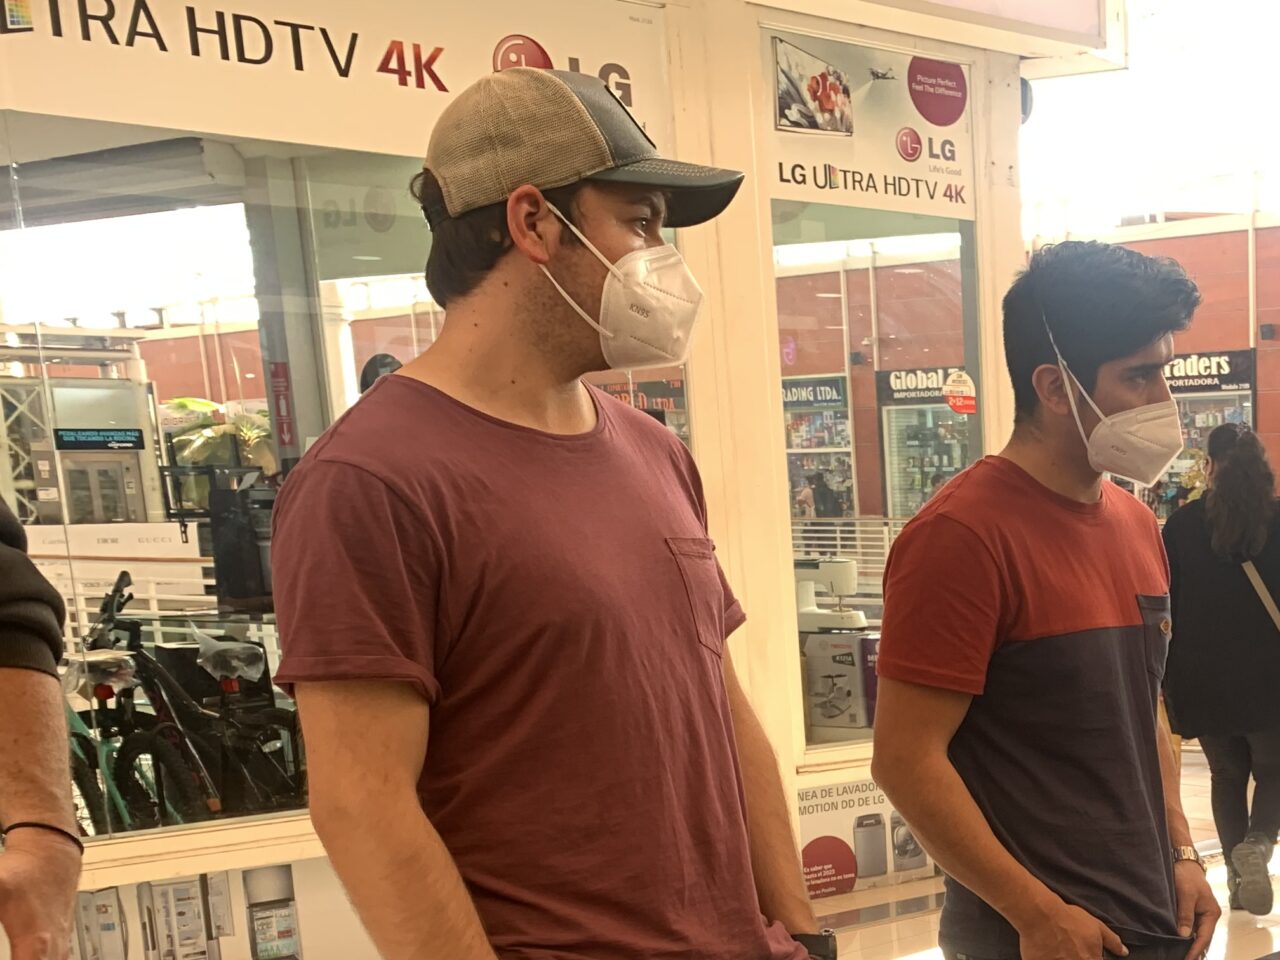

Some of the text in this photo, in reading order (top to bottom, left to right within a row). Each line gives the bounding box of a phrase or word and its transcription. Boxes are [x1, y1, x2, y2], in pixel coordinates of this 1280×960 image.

[185, 5, 359, 78] HDTV
[377, 39, 450, 93] 4K
[927, 137, 956, 162] LG
[946, 166, 962, 176] Good
[778, 162, 967, 204] LG ULTRA HDTV 4K
[890, 368, 944, 390] Global
[820, 783, 834, 799] DE
[798, 794, 885, 816] MOTION DD DE LG
